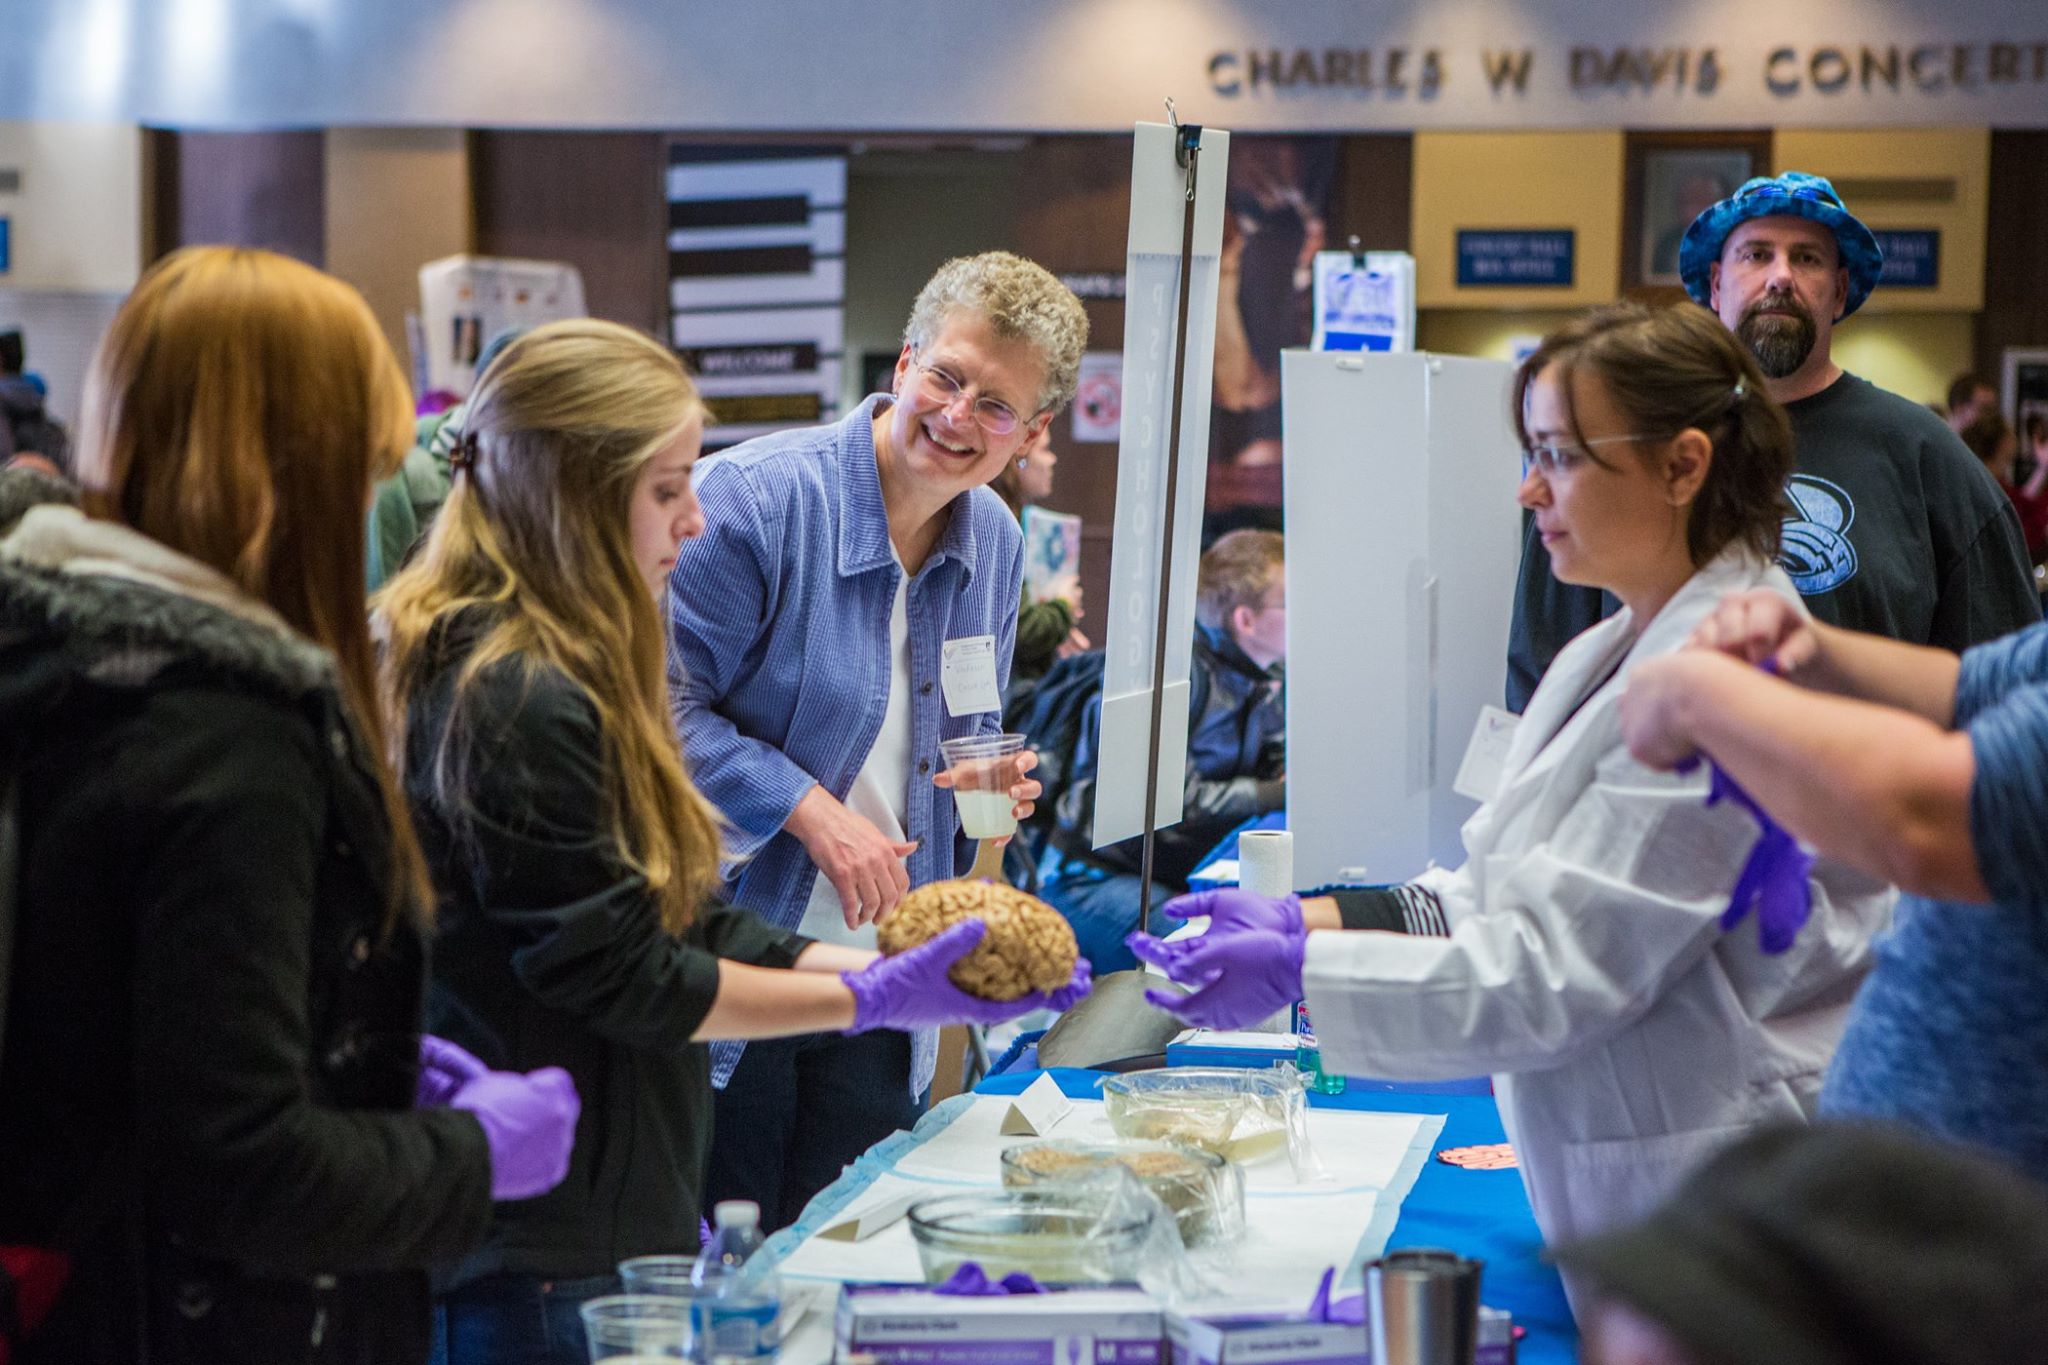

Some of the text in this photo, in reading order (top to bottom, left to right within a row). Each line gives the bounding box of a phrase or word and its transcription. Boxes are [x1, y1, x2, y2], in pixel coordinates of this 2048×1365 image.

[1207, 42, 2048, 99] CHARLES W DAVIS CONCERT
